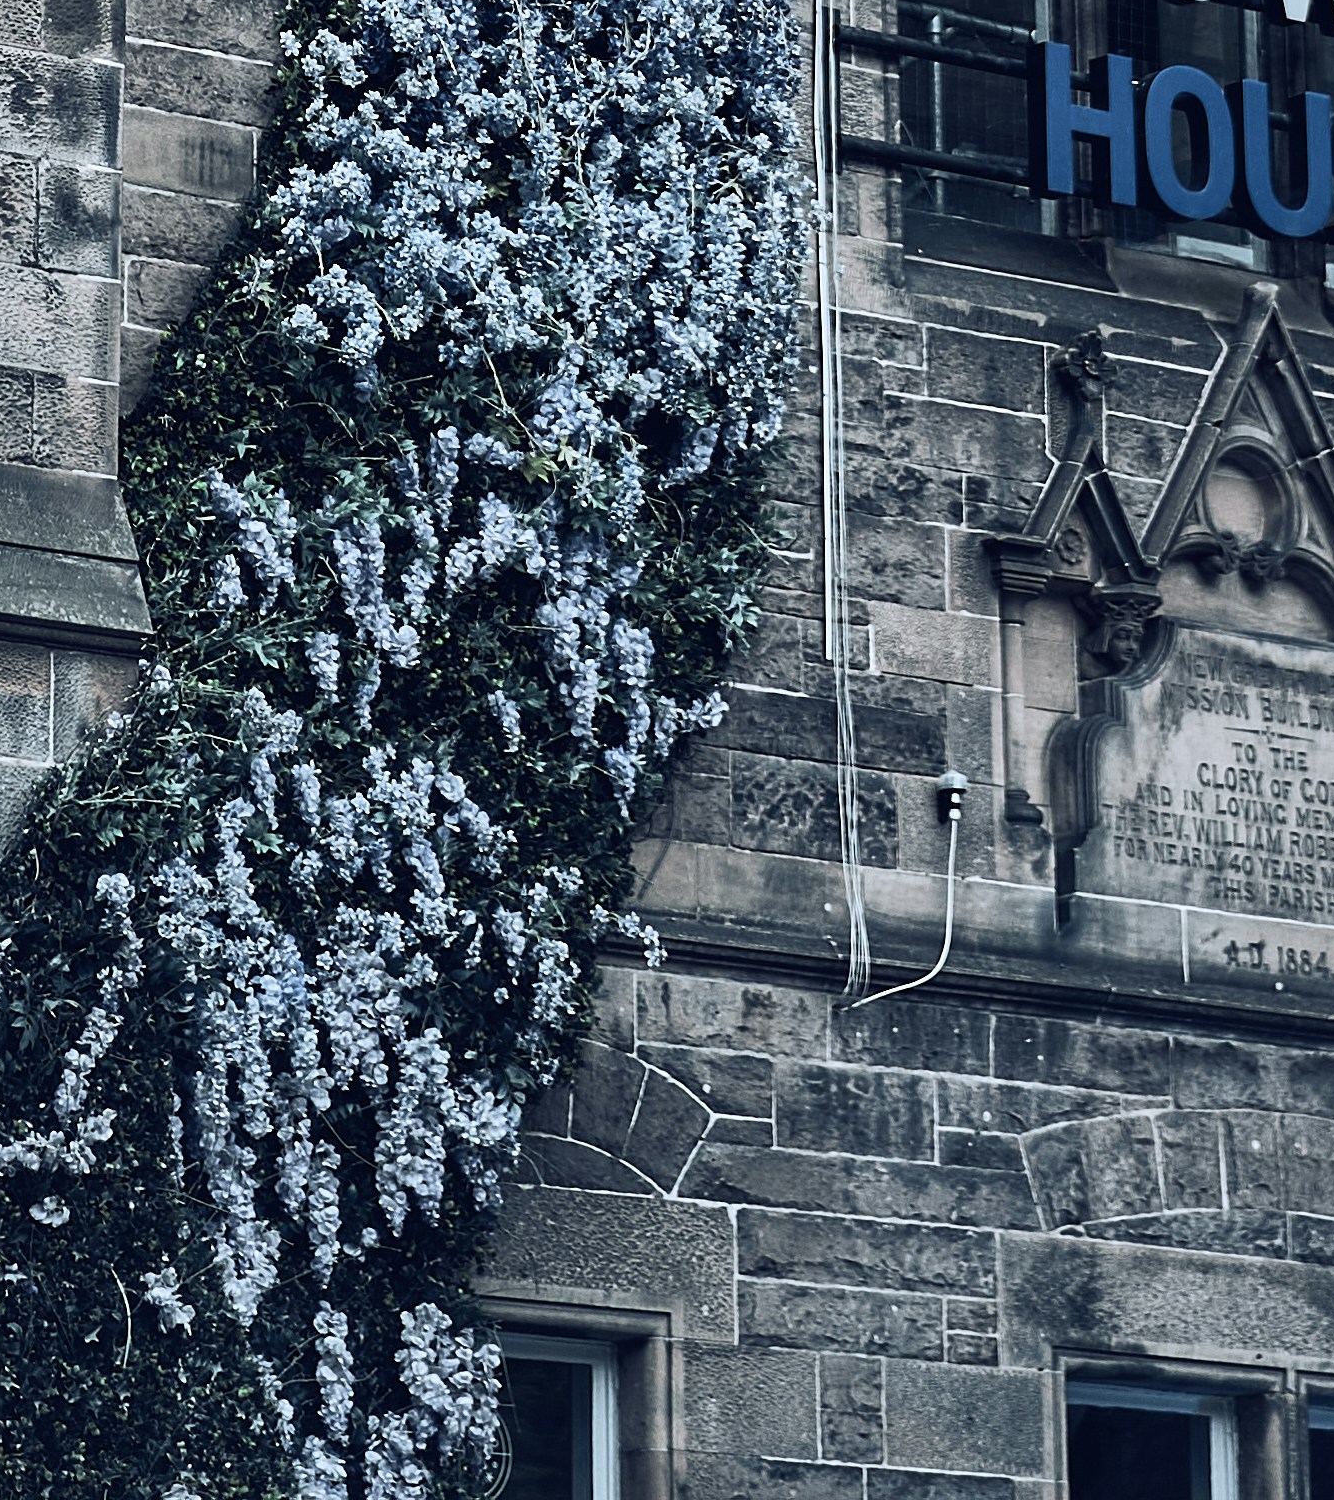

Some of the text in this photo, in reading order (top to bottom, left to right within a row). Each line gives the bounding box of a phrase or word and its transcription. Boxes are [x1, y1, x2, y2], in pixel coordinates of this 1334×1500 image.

[1231, 741, 1309, 773] TO THE
[1196, 762, 1265, 796] GLORY
[1269, 778, 1293, 800] OF
[1134, 782, 1173, 807] AND
[1183, 789, 1205, 813] IN
[1214, 793, 1288, 825] LOVING
[1101, 802, 1142, 833] THE
[1191, 816, 1284, 855] WILLIAM
[1113, 835, 1149, 862] FOR
[1153, 840, 1226, 872] NEARLY
[1227, 853, 1255, 877] 40
[1258, 856, 1316, 886] YEARS
[1206, 875, 1256, 902] THIS
